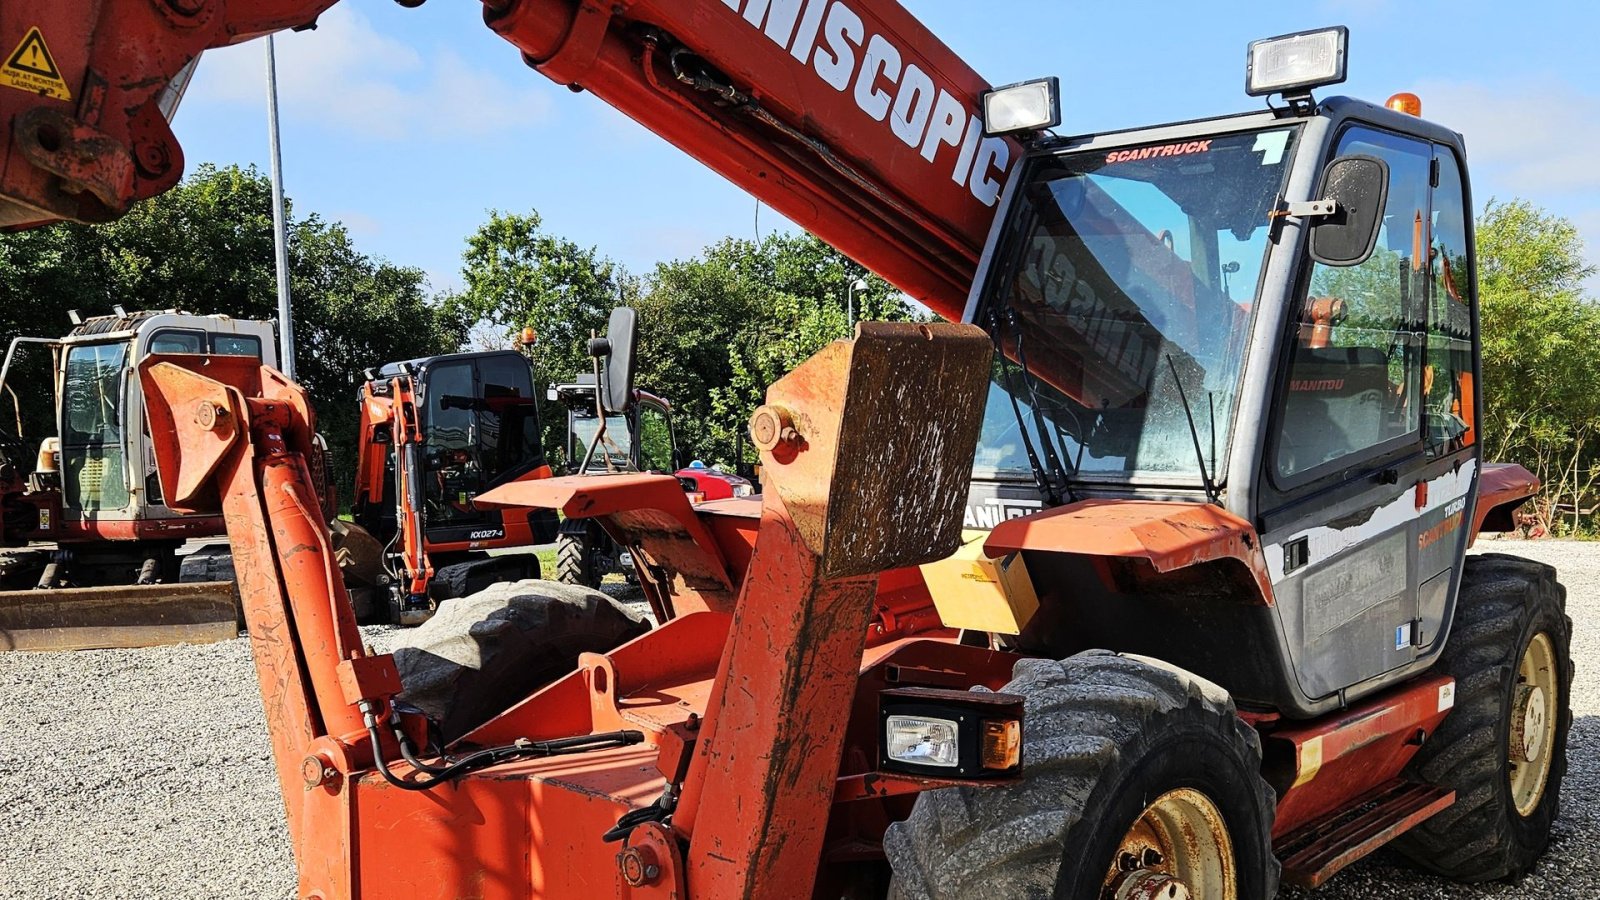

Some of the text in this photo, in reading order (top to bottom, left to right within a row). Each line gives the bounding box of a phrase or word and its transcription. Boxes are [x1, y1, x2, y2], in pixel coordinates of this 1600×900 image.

[721, 0, 1010, 208] NISCOPIC
[1105, 139, 1213, 164] SCANTRUCK
[1290, 379, 1344, 391] MANITOU
[1445, 497, 1466, 518] TURBO
[470, 529, 504, 539] KX027-4
